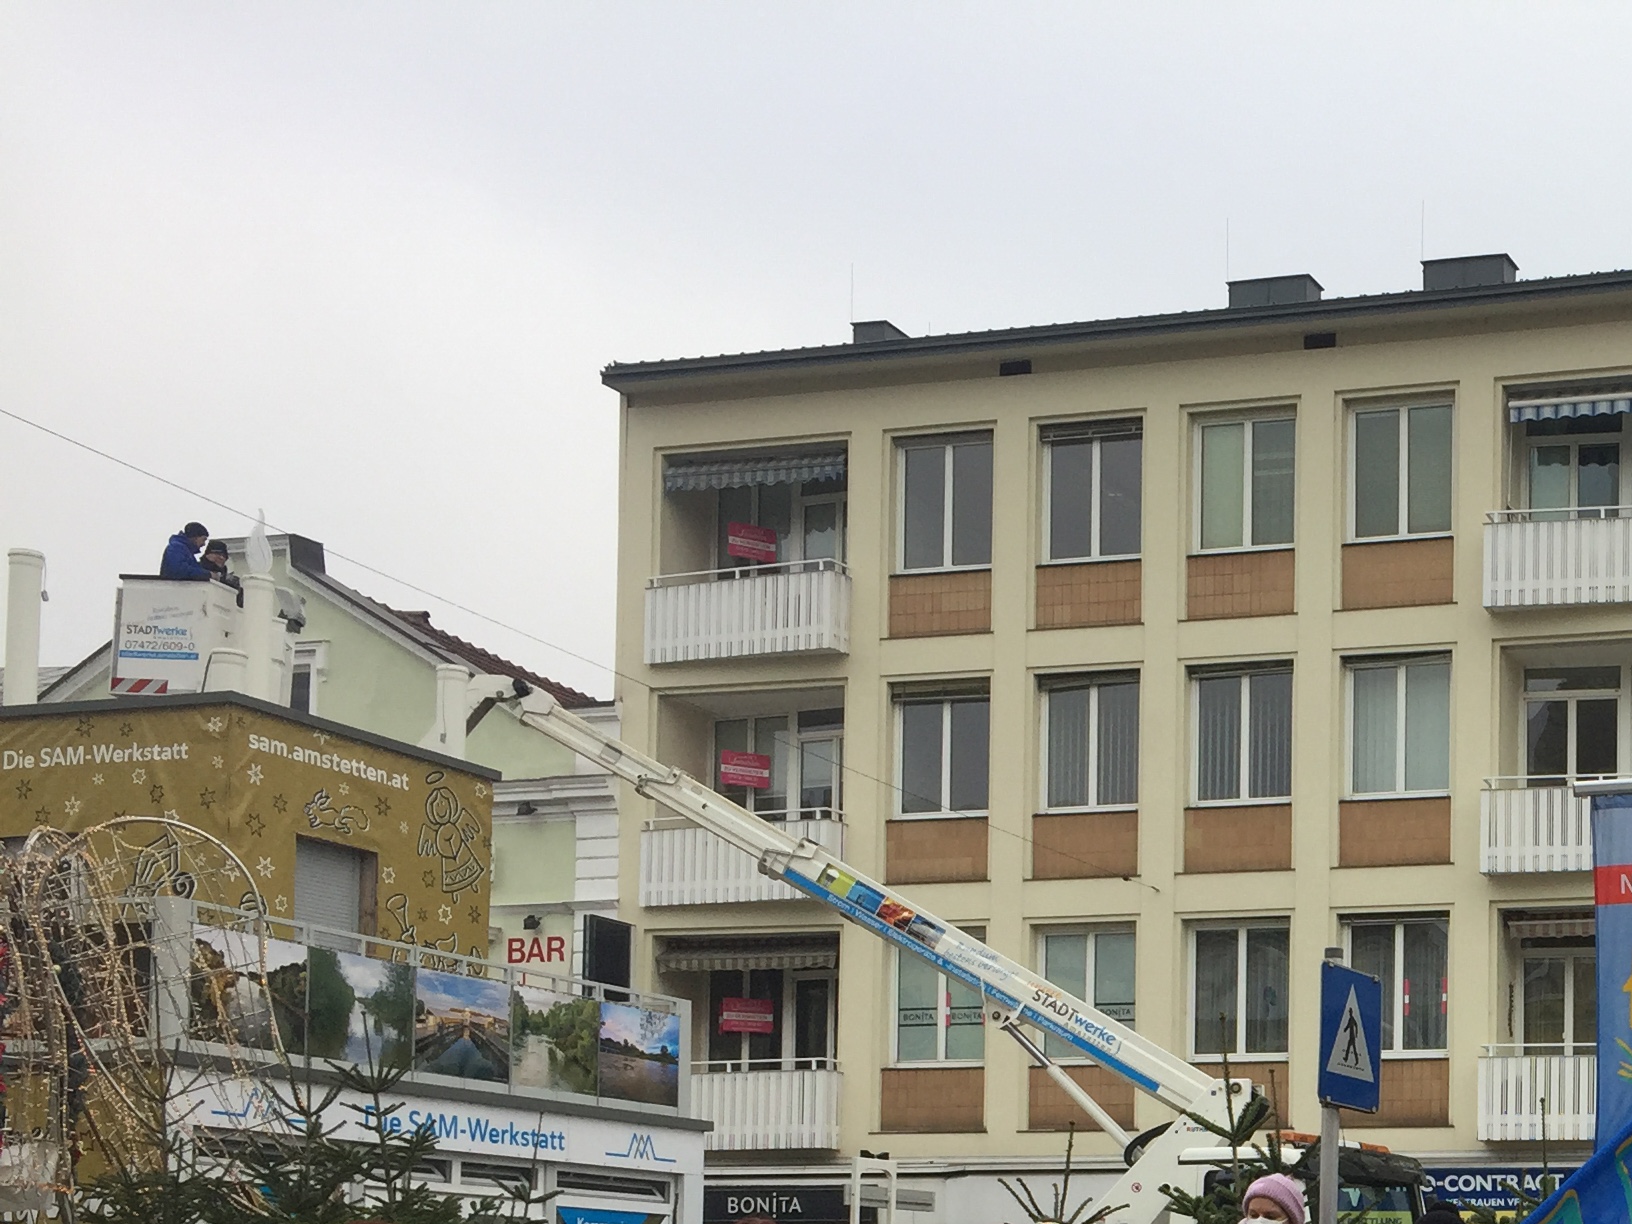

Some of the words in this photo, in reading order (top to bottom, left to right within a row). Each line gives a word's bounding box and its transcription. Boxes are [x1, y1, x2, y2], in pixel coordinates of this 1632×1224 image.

[125, 640, 195, 651] 07472/609-0
[126, 624, 188, 636] STADTwerke
[3, 750, 35, 770] Die
[39, 742, 189, 768] SAM-Werkstatt
[248, 733, 410, 791] sam.amstetten.at
[827, 894, 850, 912] Strom
[854, 908, 883, 930] Wasser
[508, 936, 565, 964] BAR
[1031, 988, 1117, 1046] STADTwerke
[408, 1109, 566, 1151] SAM-Werkstatt
